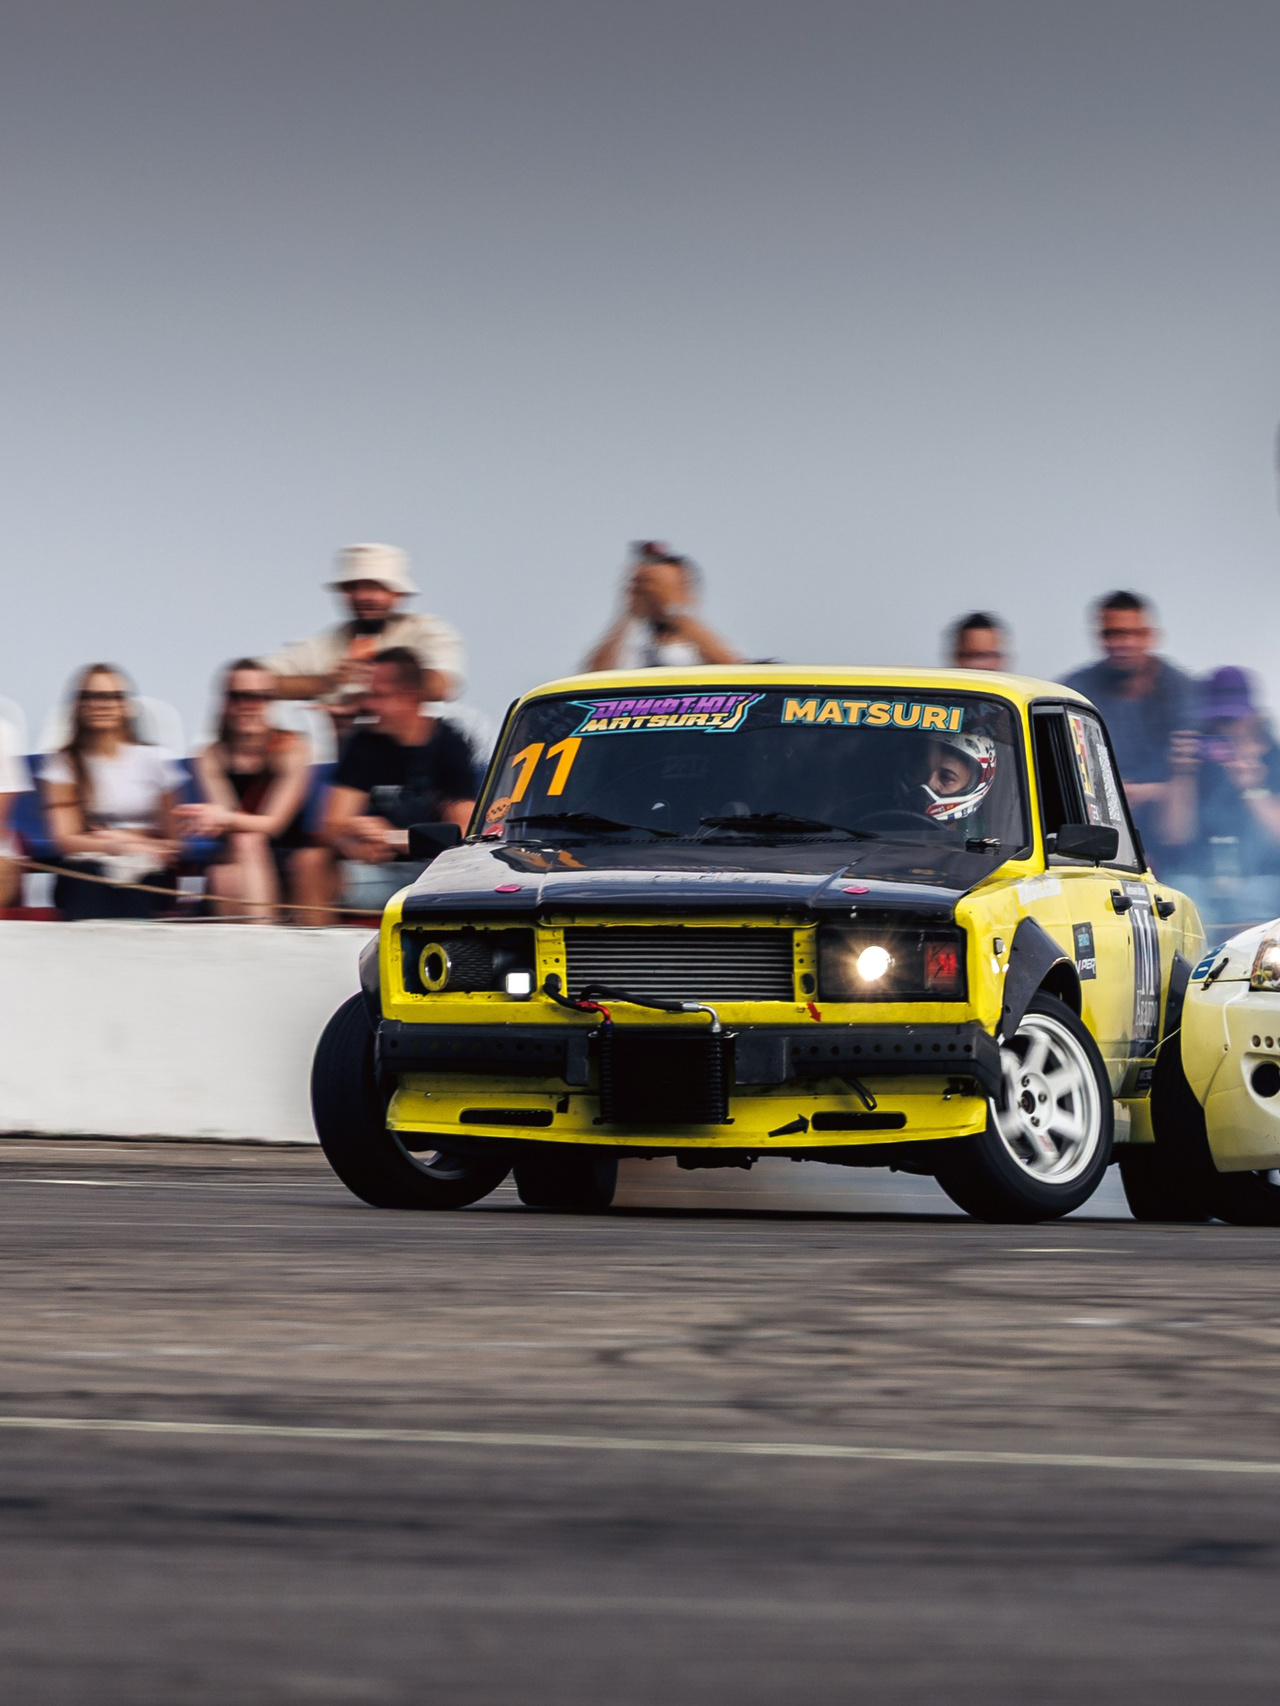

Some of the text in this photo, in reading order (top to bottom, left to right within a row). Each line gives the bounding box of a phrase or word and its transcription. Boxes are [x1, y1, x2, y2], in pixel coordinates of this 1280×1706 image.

[580, 713, 730, 732] MATSURI
[783, 699, 963, 732] MATSURI
[510, 737, 582, 803] 11
